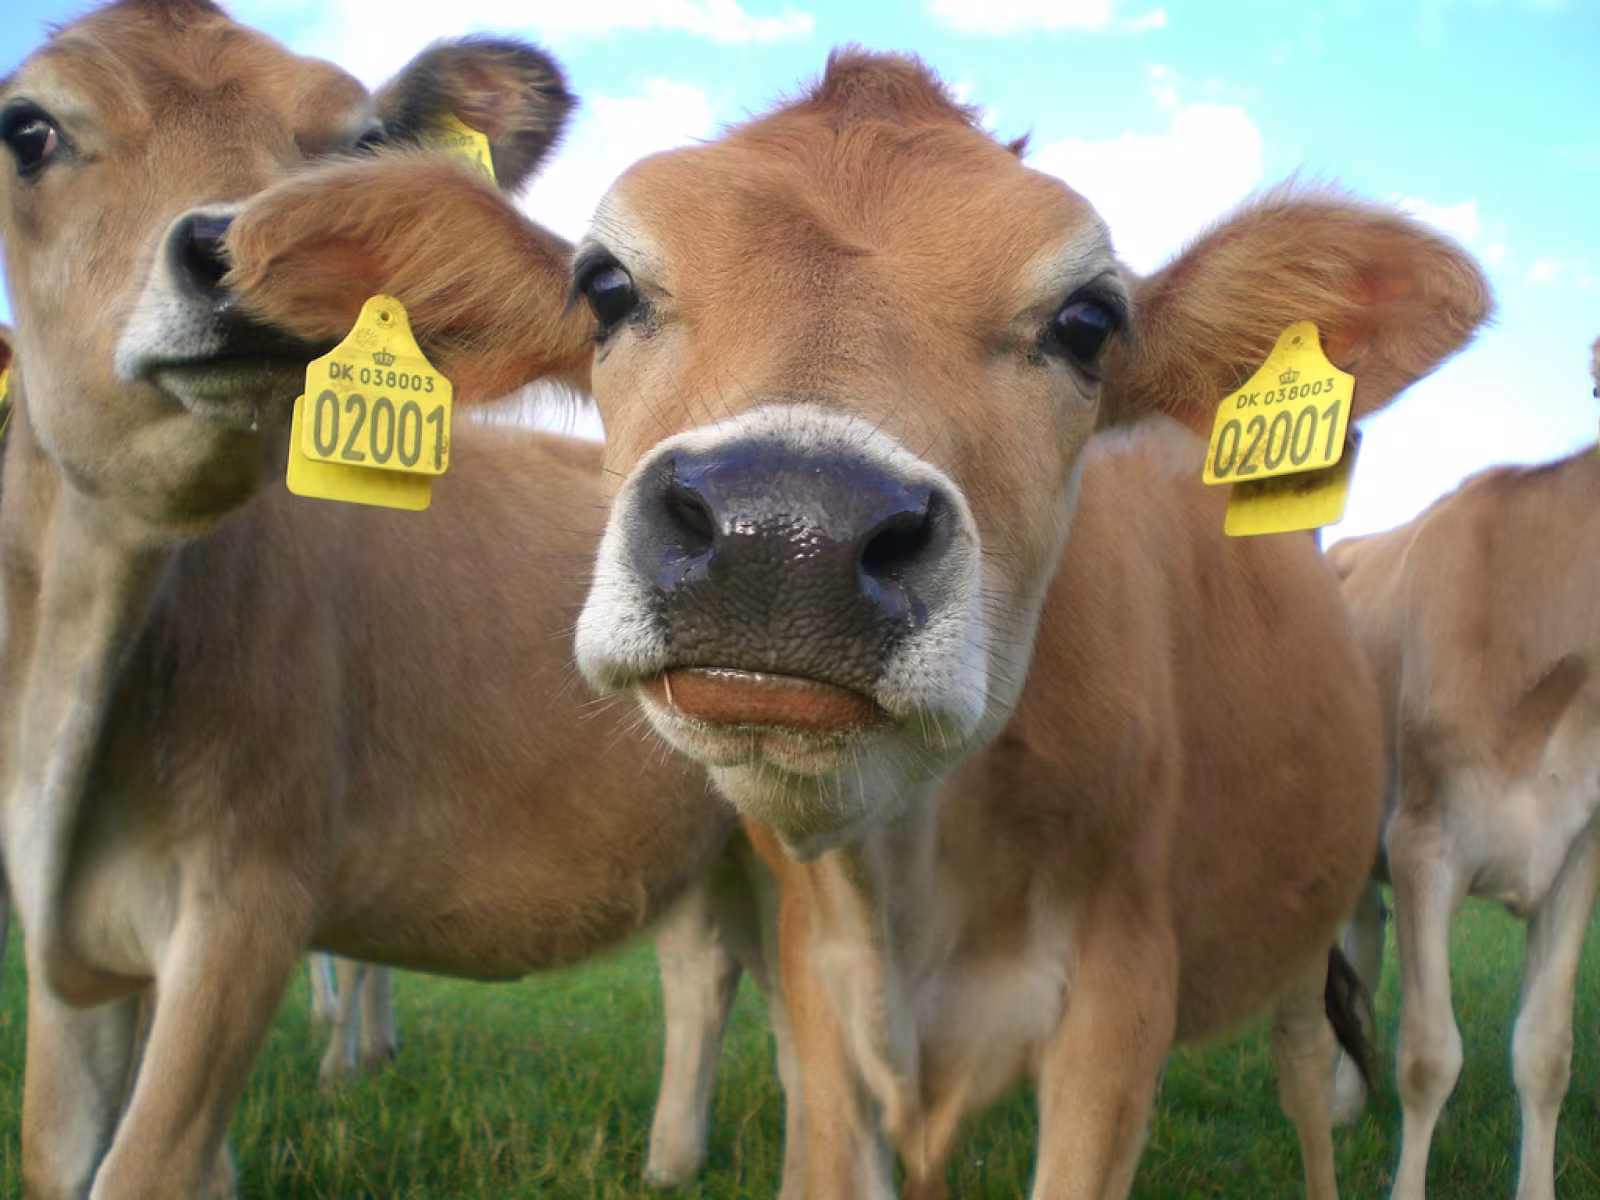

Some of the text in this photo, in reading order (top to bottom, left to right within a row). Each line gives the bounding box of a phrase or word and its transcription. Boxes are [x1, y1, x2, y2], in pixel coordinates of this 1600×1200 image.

[329, 361, 434, 393] DK 038003
[1236, 378, 1335, 409] DK 038003
[313, 389, 444, 471] 02001
[1213, 399, 1342, 479] 02001
